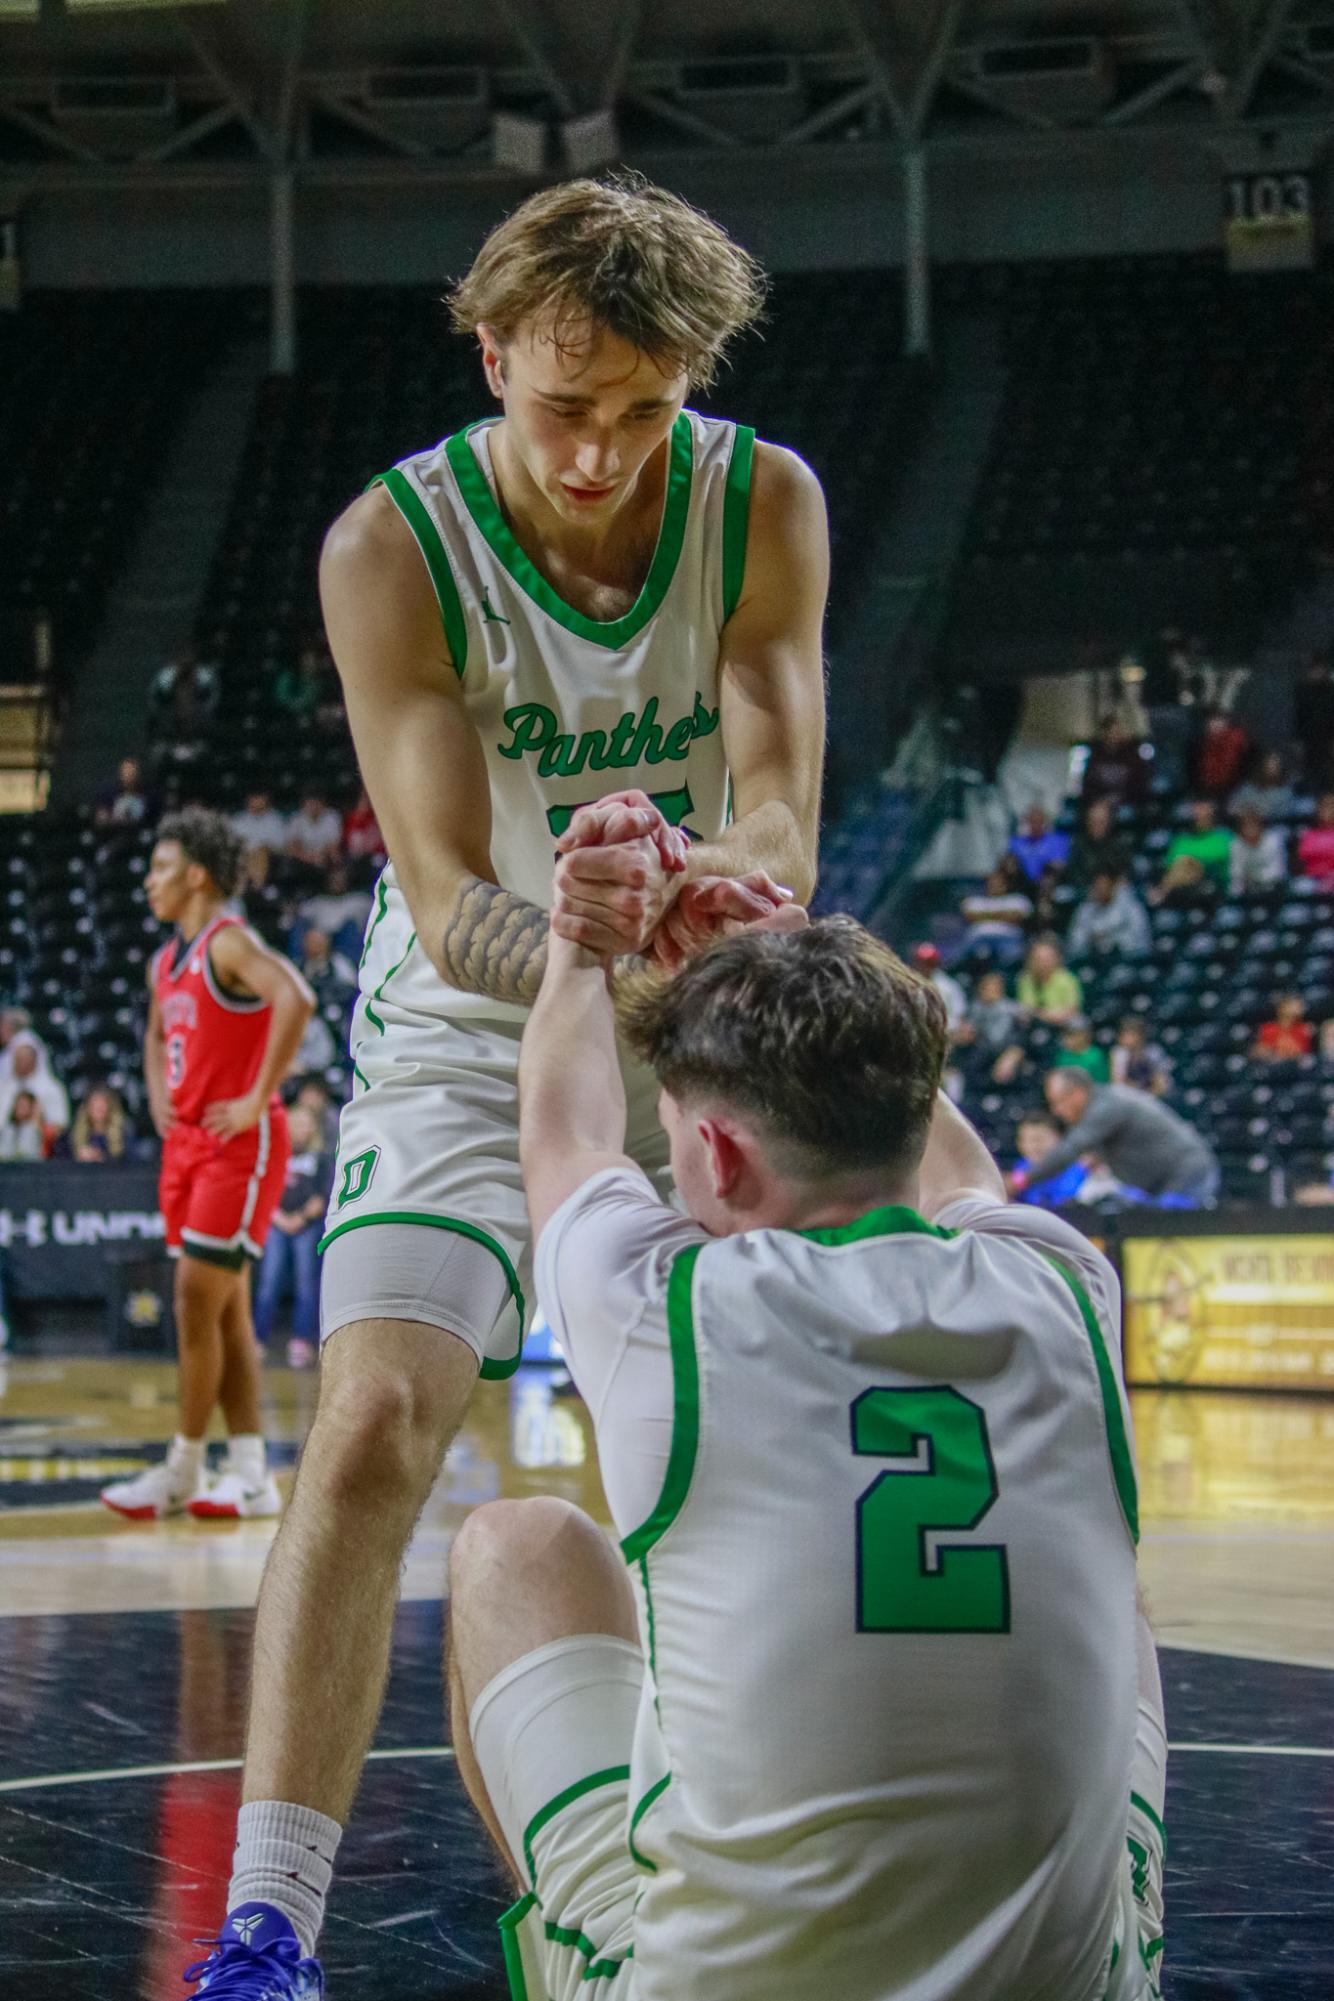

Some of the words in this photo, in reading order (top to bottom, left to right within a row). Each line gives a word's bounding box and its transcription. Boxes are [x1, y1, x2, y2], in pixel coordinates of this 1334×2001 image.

[1229, 176, 1311, 220] 103
[498, 691, 719, 777] Panthes
[849, 1385, 1011, 1634] 2
